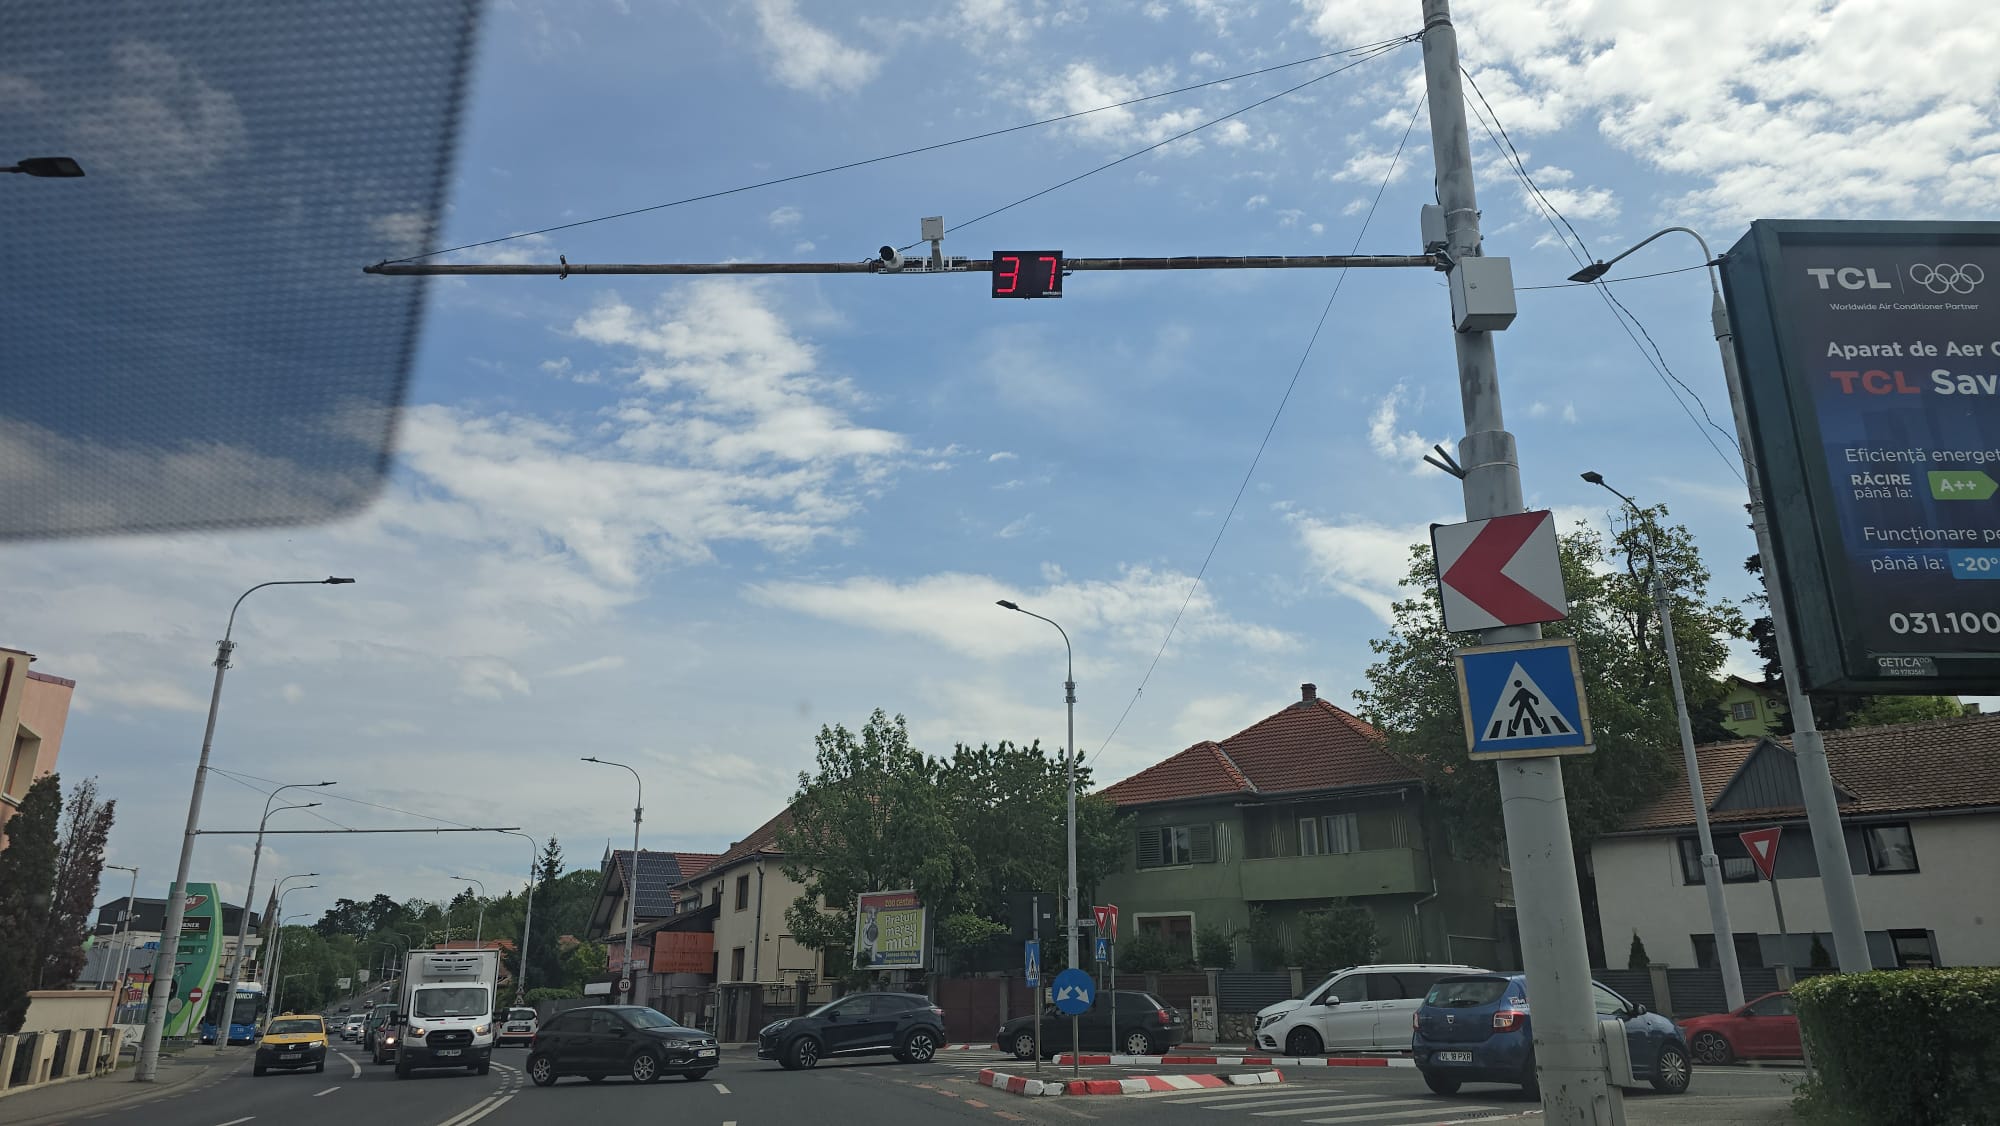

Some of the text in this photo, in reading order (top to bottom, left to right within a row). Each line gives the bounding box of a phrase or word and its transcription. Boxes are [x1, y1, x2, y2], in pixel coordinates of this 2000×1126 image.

[1807, 267, 1892, 290] TCL
[1827, 341, 1903, 360] Aparat
[1909, 341, 1938, 357] de
[1946, 341, 1983, 357] Aer
[1830, 370, 1920, 395] TCL
[1846, 448, 1926, 464] Eficiență
[1851, 471, 1912, 486] RĂCIRE
[1940, 478, 1977, 493] A++
[1854, 487, 1912, 500] până la:
[1864, 526, 1978, 544] Funcționare
[1871, 555, 1918, 573] până
[1923, 555, 1945, 570] la:
[1889, 612, 2000, 634] 031.100
[1878, 657, 1920, 667] GETICA
